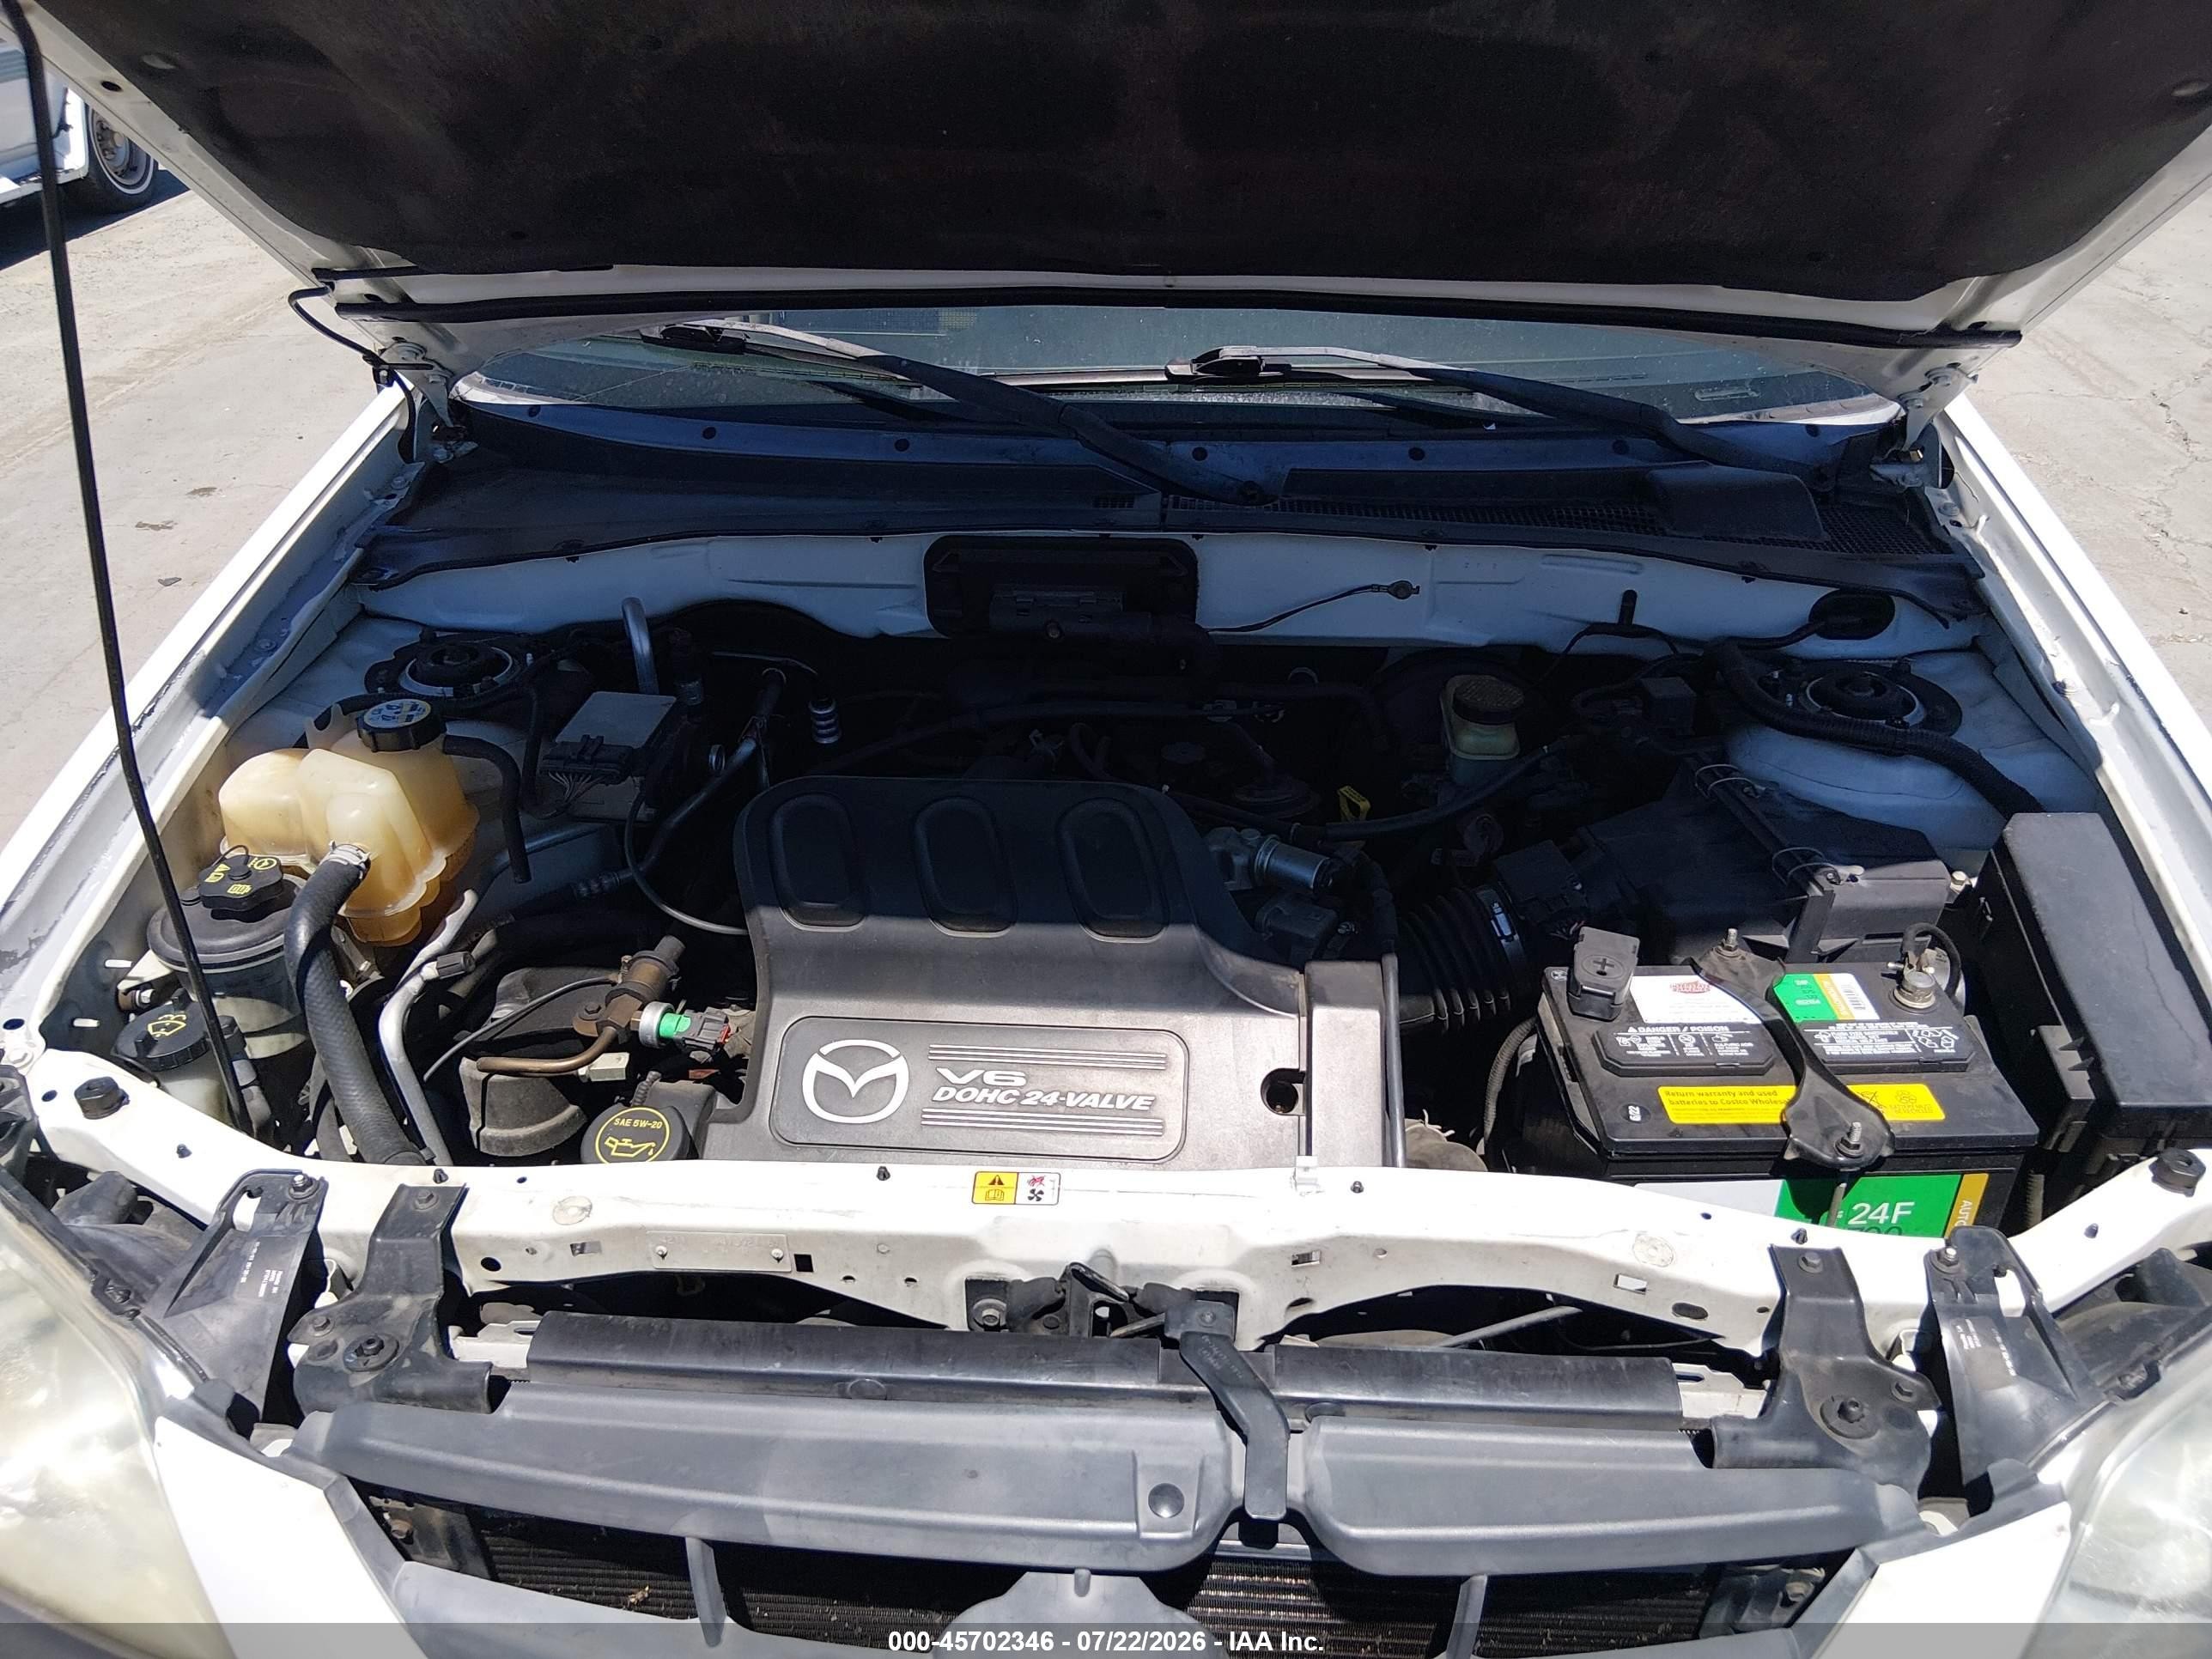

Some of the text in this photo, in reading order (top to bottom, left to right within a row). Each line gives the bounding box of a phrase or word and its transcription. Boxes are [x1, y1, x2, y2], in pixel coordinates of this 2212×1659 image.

[936, 1067, 1028, 1086] V6
[932, 1086, 1156, 1110] DOHC 24-VALVE
[613, 1118, 663, 1129] SAE 5W-20
[1847, 1201, 1915, 1224] 24F
